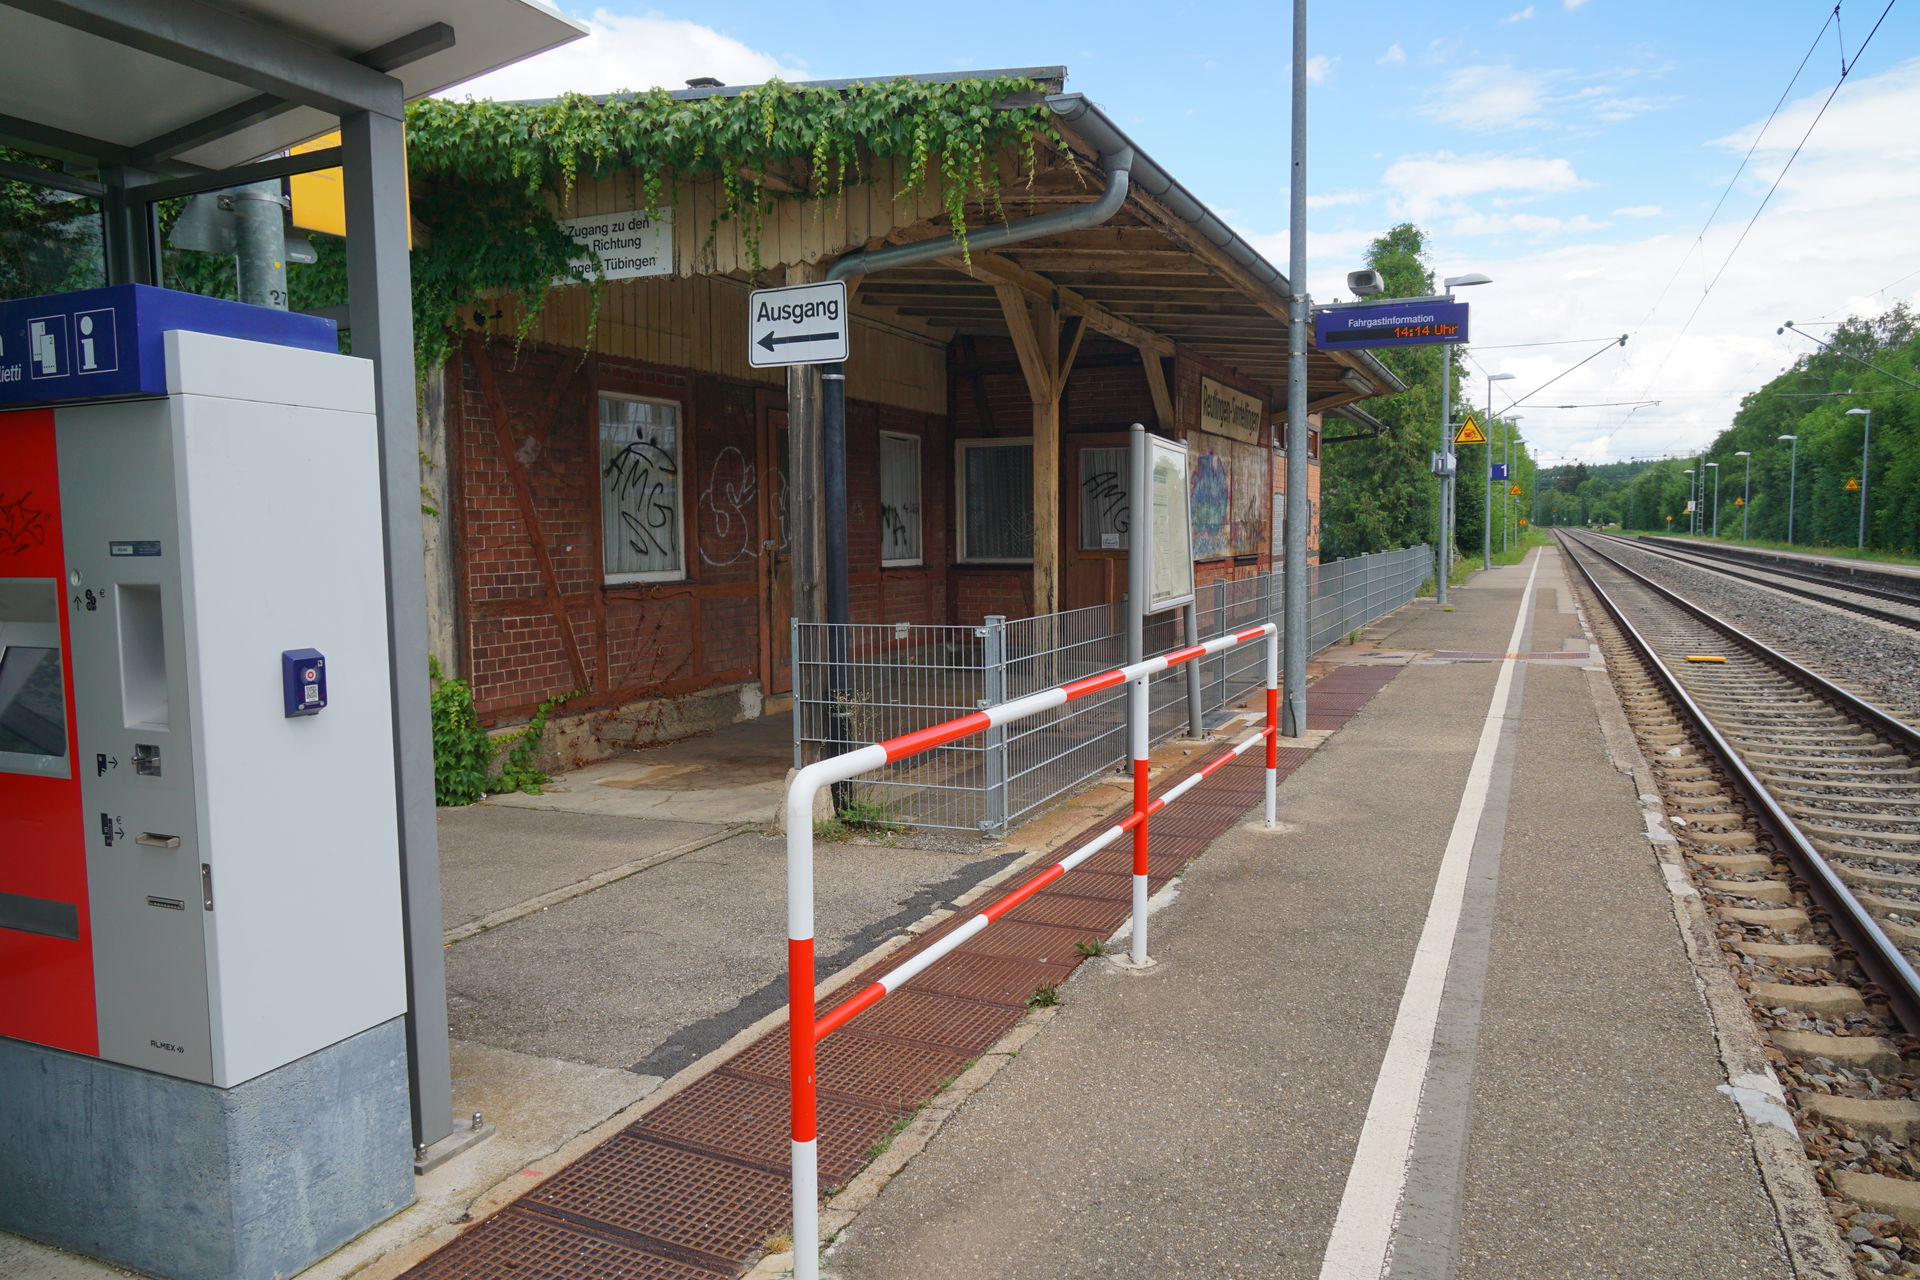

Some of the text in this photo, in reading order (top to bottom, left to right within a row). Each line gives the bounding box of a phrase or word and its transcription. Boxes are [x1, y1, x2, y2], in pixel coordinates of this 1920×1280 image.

[568, 225, 608, 239] Zugang
[612, 222, 625, 233] zu
[628, 217, 649, 231] den
[593, 237, 642, 252] Richtung
[757, 299, 839, 324] Ausgang
[1348, 314, 1434, 328] Fahrgastinformation
[1394, 324, 1459, 338] 14:14 Uhr
[1500, 464, 1508, 477] 1
[150, 1039, 176, 1052] ALMEX
